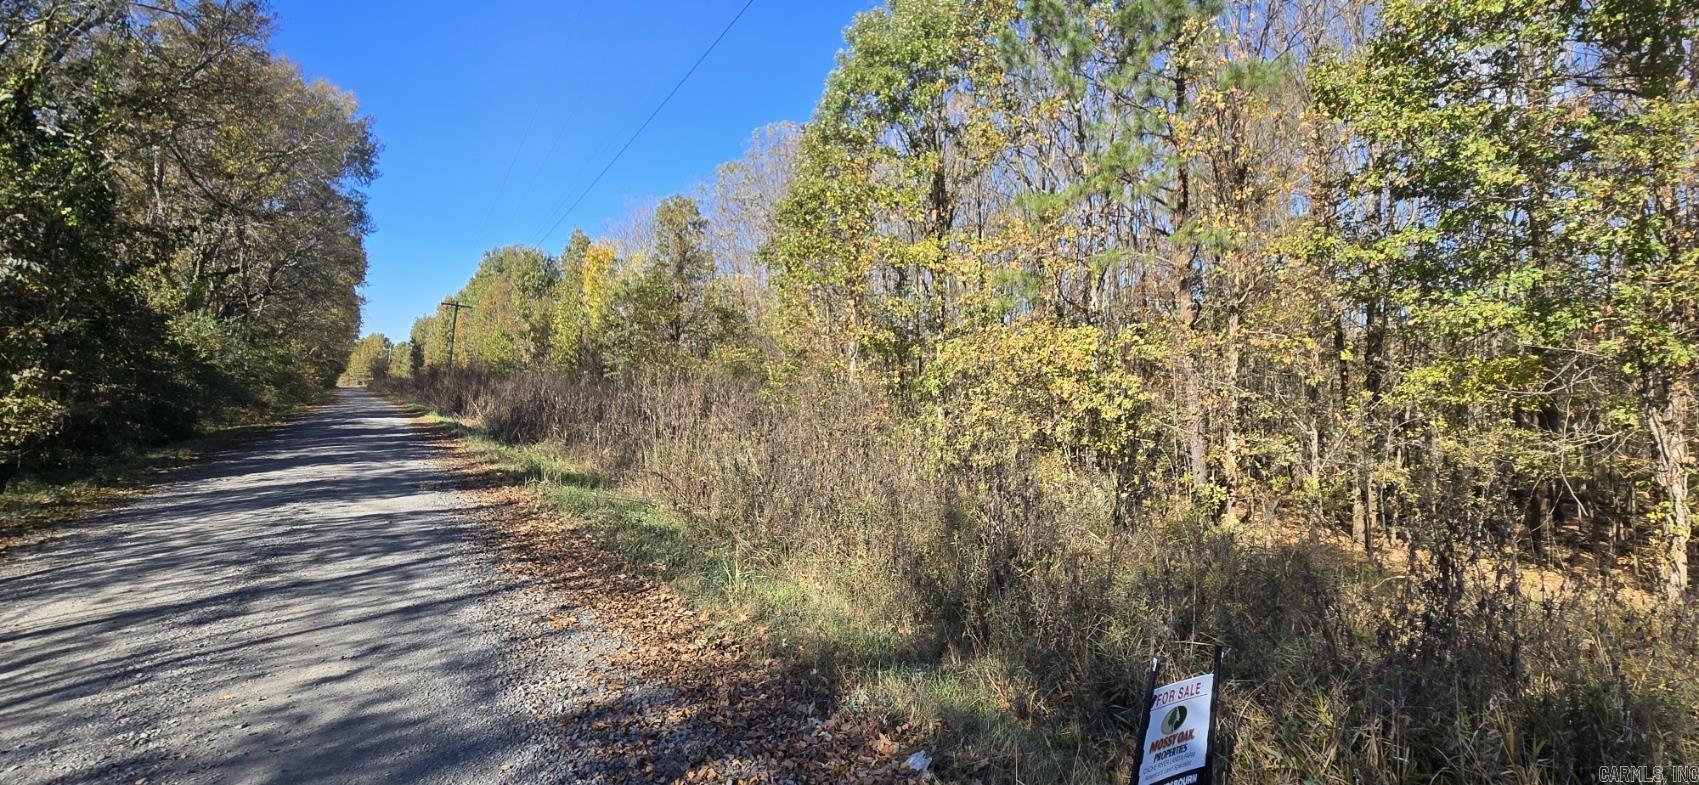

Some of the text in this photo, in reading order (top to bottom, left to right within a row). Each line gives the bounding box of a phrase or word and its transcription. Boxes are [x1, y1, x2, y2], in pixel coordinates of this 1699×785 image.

[1156, 682, 1201, 706] FOR SALE
[1149, 728, 1195, 753] MOSSY OAK
[1154, 744, 1187, 763] PROPERTIES
